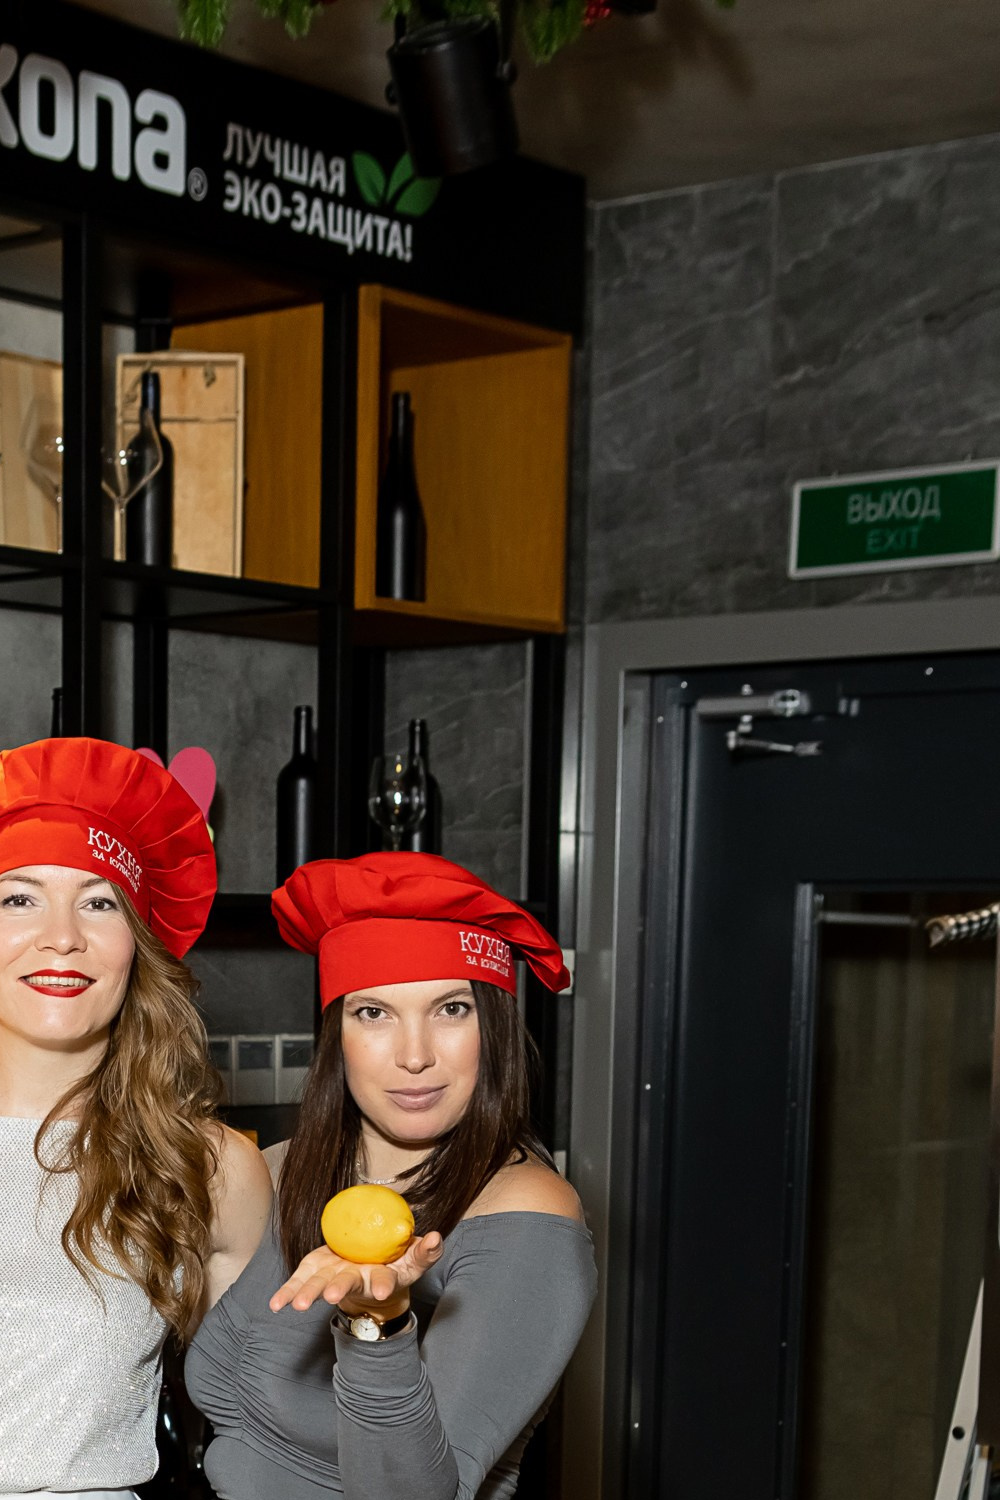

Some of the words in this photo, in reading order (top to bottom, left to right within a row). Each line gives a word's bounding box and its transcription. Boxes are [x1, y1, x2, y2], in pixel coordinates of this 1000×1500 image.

[223, 123, 346, 197] ЛУЧШАЯ
[223, 171, 413, 262] ЭКО-ЗАЩИТА!
[847, 485, 941, 524] ВЫХОД
[866, 525, 920, 554] EXIT
[459, 931, 511, 966] КУХНЯ
[466, 955, 478, 966] ЗА
